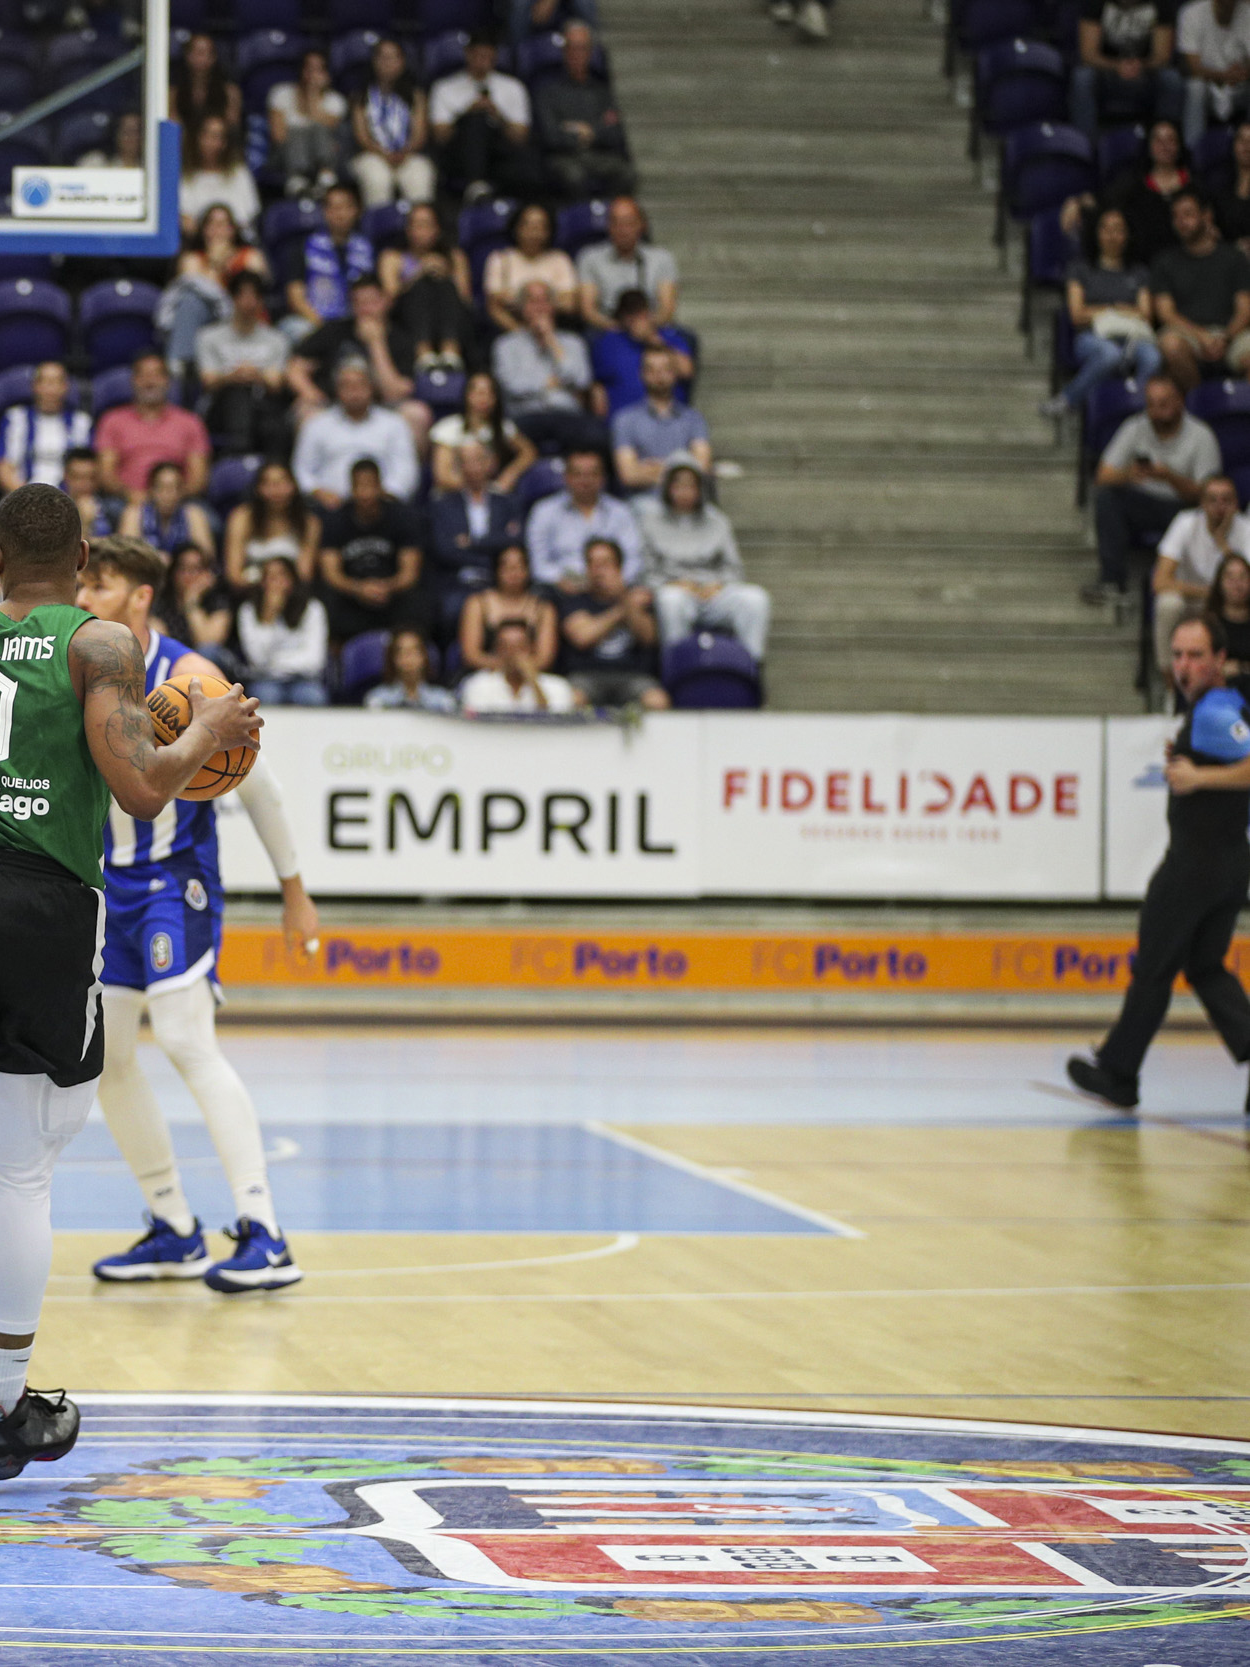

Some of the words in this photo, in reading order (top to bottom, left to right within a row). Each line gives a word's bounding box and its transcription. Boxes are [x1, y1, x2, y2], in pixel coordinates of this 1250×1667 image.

[323, 743, 453, 776] GRUPO
[1, 775, 50, 790] QUEIJOS
[721, 767, 1080, 818] FIDELIDADE
[326, 788, 676, 854] EMPRIL
[325, 937, 442, 977] Porto
[573, 940, 688, 980] Porto
[813, 942, 928, 982] Porto
